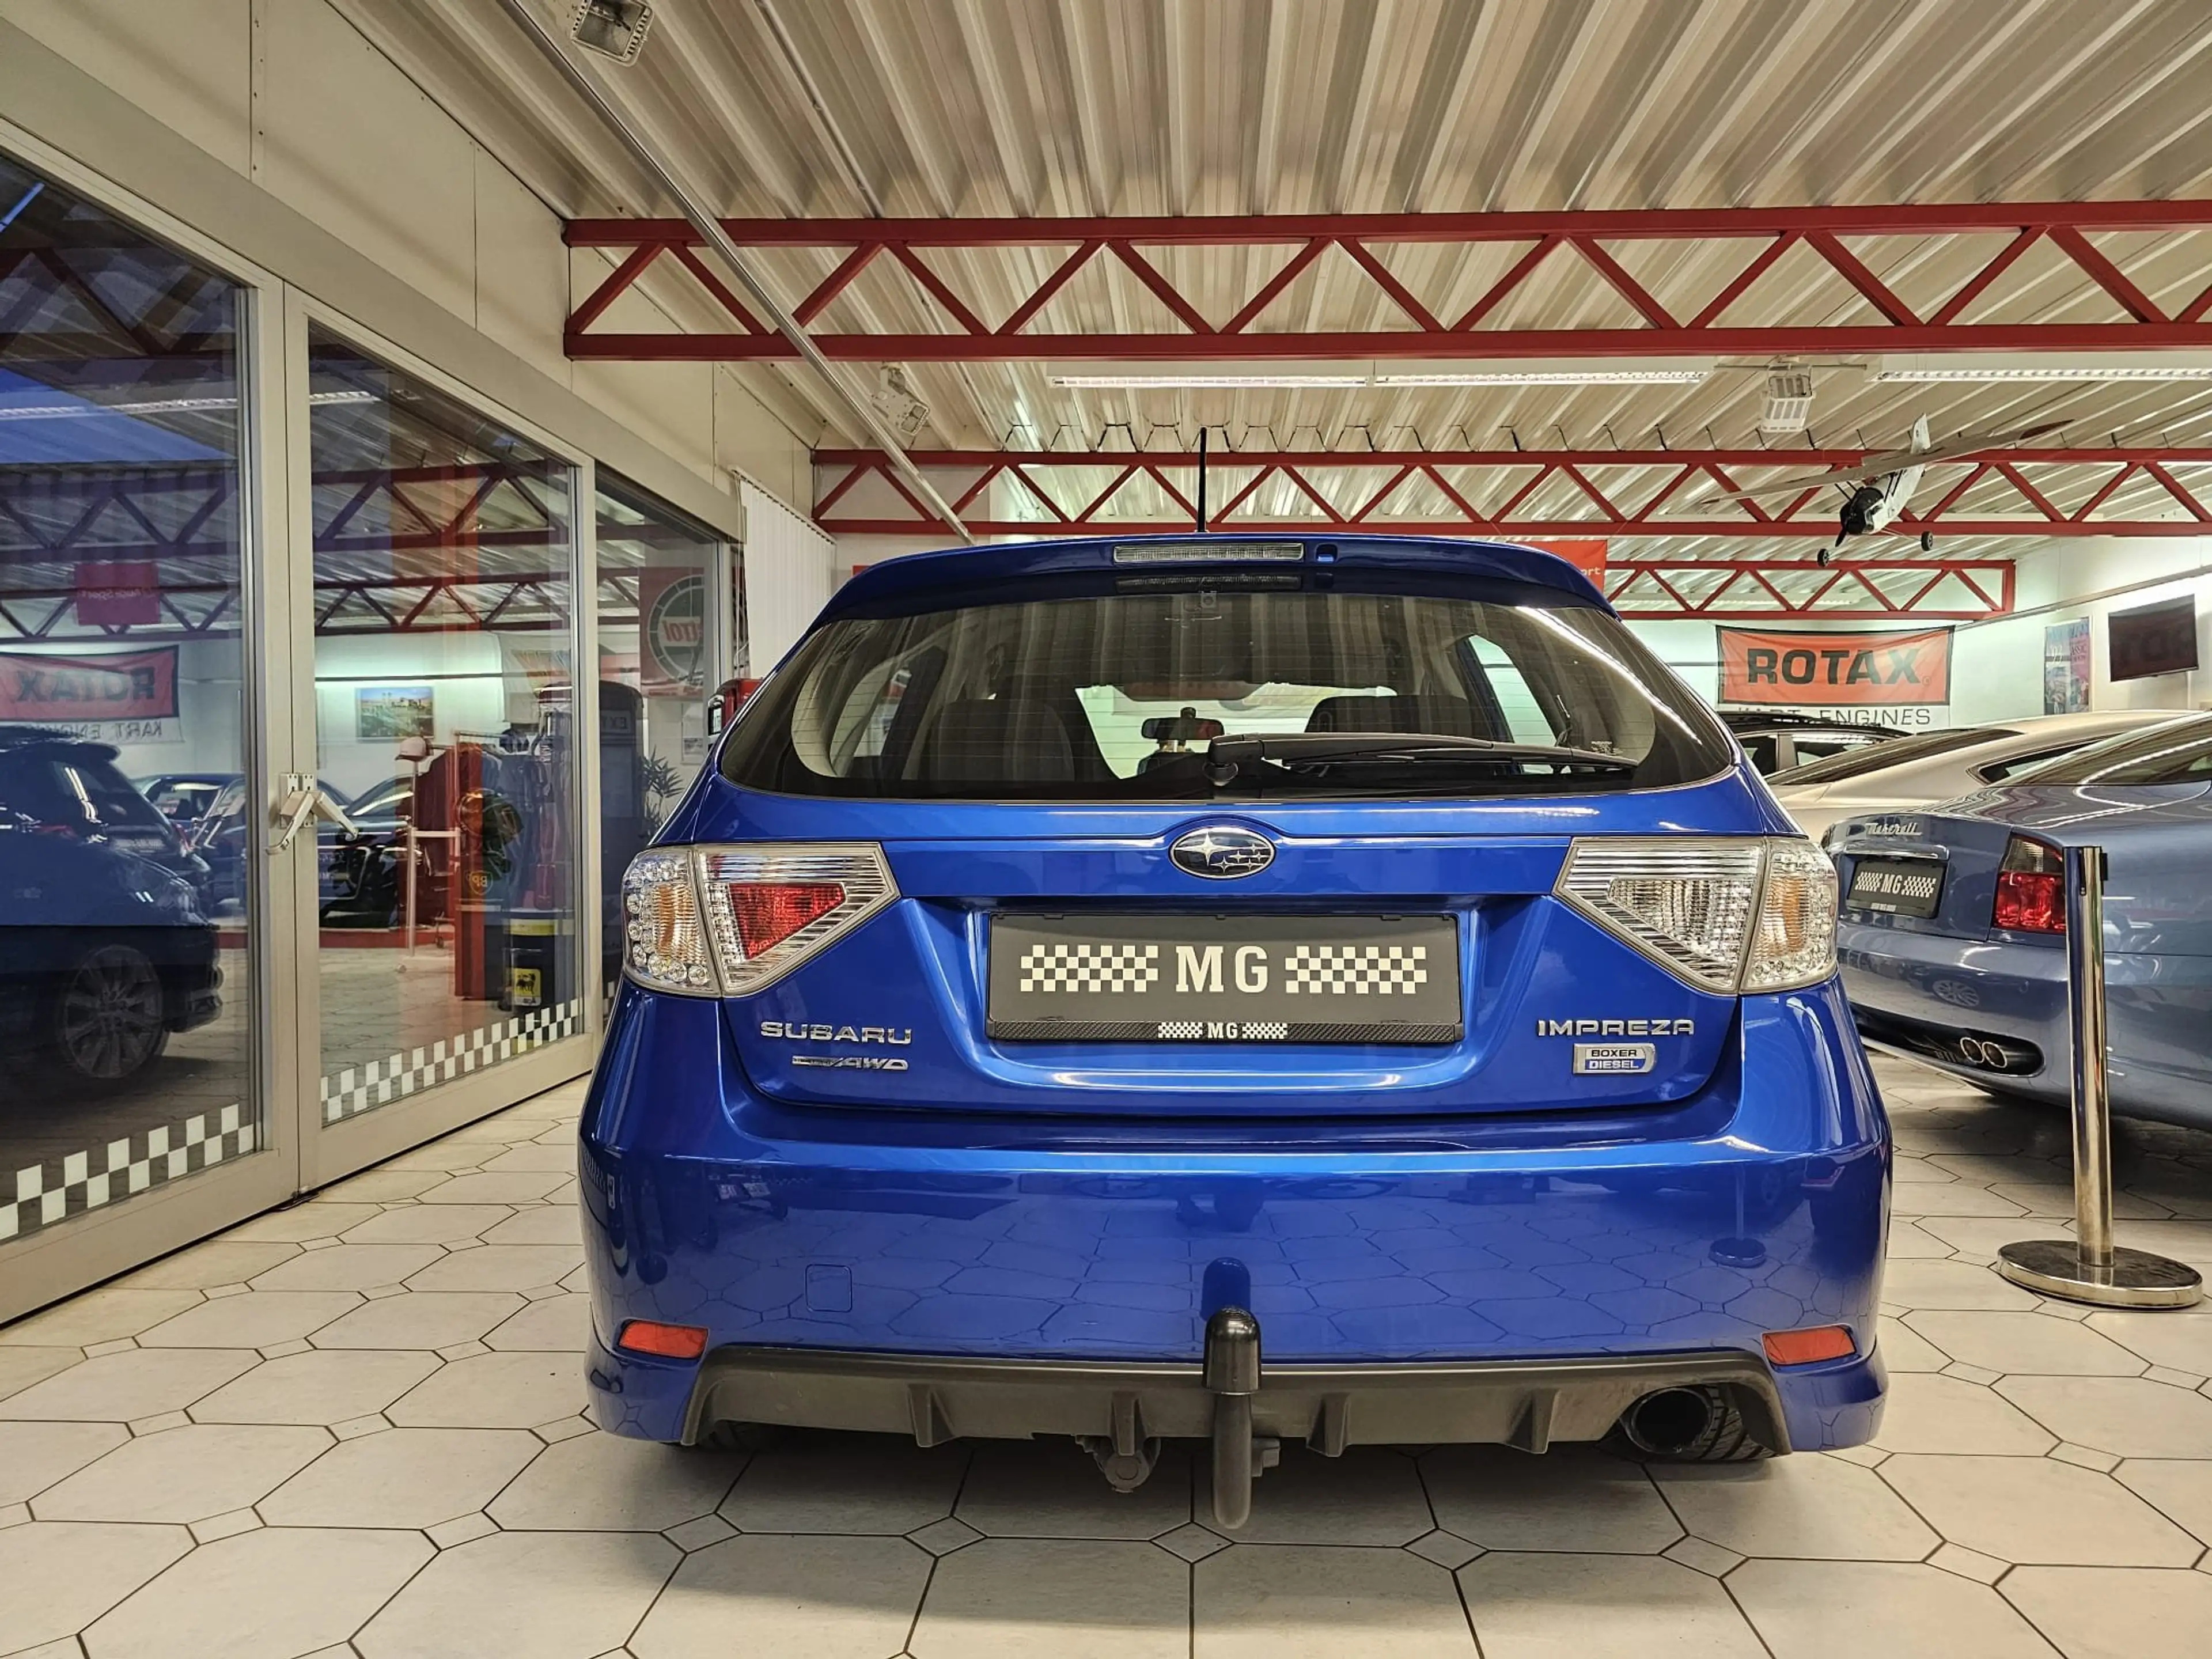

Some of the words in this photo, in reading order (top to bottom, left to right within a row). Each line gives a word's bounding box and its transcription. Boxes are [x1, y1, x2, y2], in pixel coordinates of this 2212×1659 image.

[1747, 648, 1922, 685] ROTAX
[1820, 708, 1931, 725] ENGINES
[1880, 873, 1902, 895] MG
[1176, 945, 1268, 993] MG
[760, 1021, 912, 1044] SUBARU
[1207, 1022, 1238, 1039] MG
[1537, 1019, 1695, 1036] IMPREZA
[1591, 1049, 1637, 1058] BOXER
[834, 1056, 909, 1070] AWD
[1588, 1060, 1639, 1069] DIESEL
